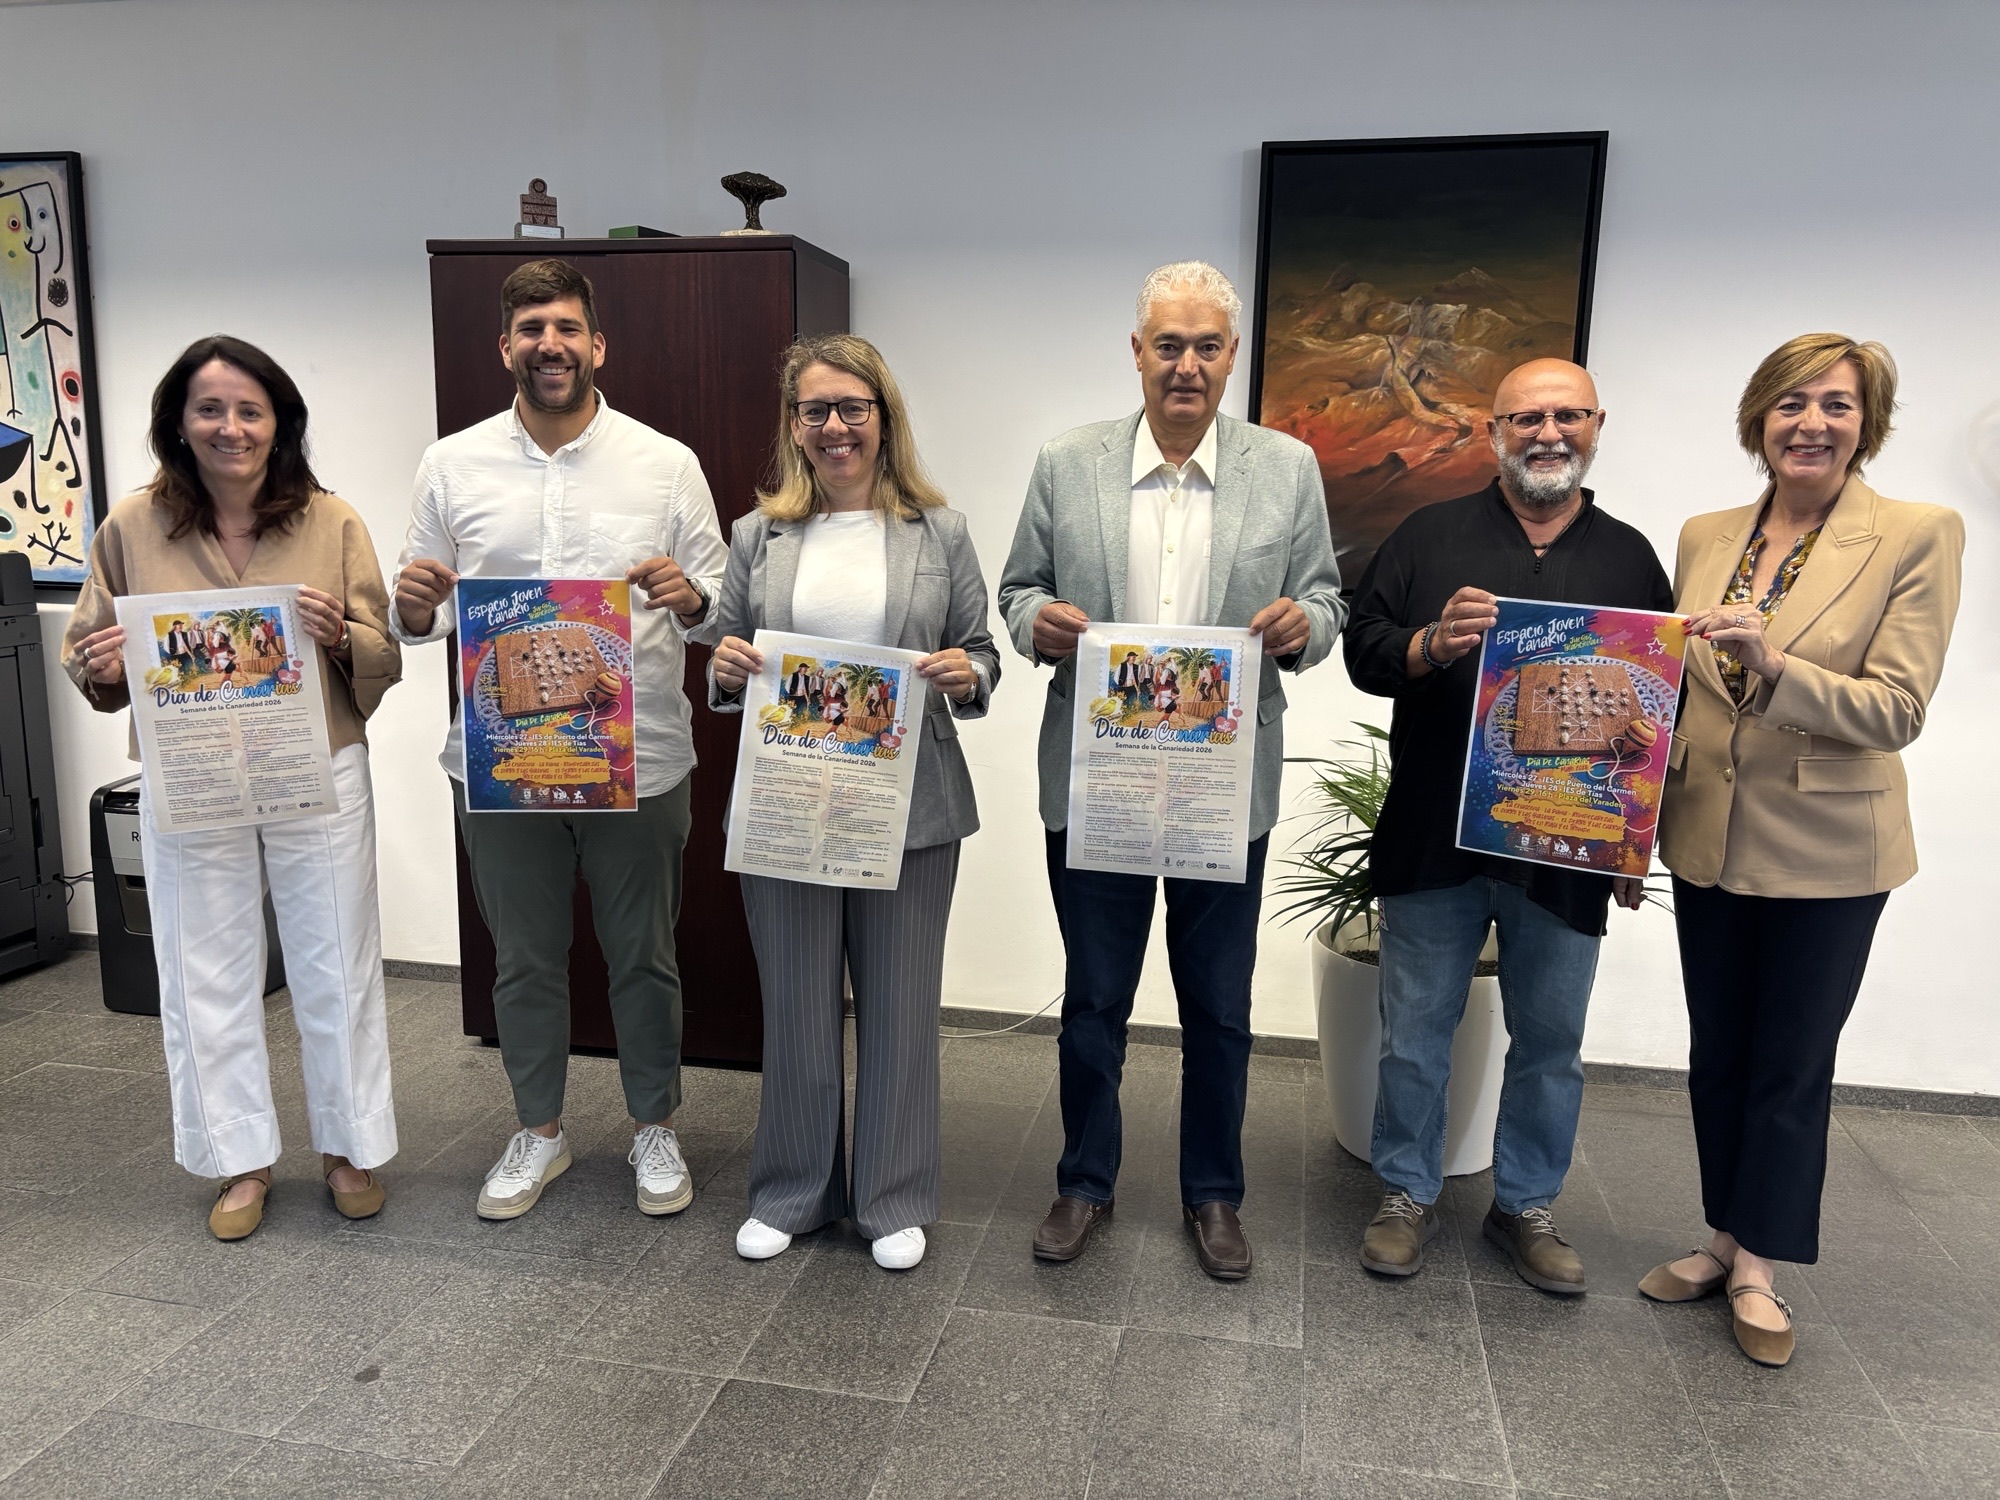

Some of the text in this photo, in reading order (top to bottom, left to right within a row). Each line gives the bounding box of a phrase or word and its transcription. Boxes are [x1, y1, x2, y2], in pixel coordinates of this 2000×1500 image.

[154, 680, 302, 707] Día de Canarias
[763, 724, 899, 760] Día de Canarias
[1095, 717, 1236, 744] Día de Canarias
[782, 750, 804, 758] Semana
[824, 755, 859, 765] Canariedad
[1492, 769, 1526, 780] Miércoles
[1567, 780, 1592, 790] Puerto
[1595, 783, 1605, 791] del
[1607, 786, 1636, 795] Carmen
[1522, 781, 1547, 790] Jueves
[1588, 790, 1602, 798] Tías
[1497, 784, 1524, 794] Viernes
[1558, 794, 1581, 803] Plaza
[1593, 798, 1626, 808] Varadero
